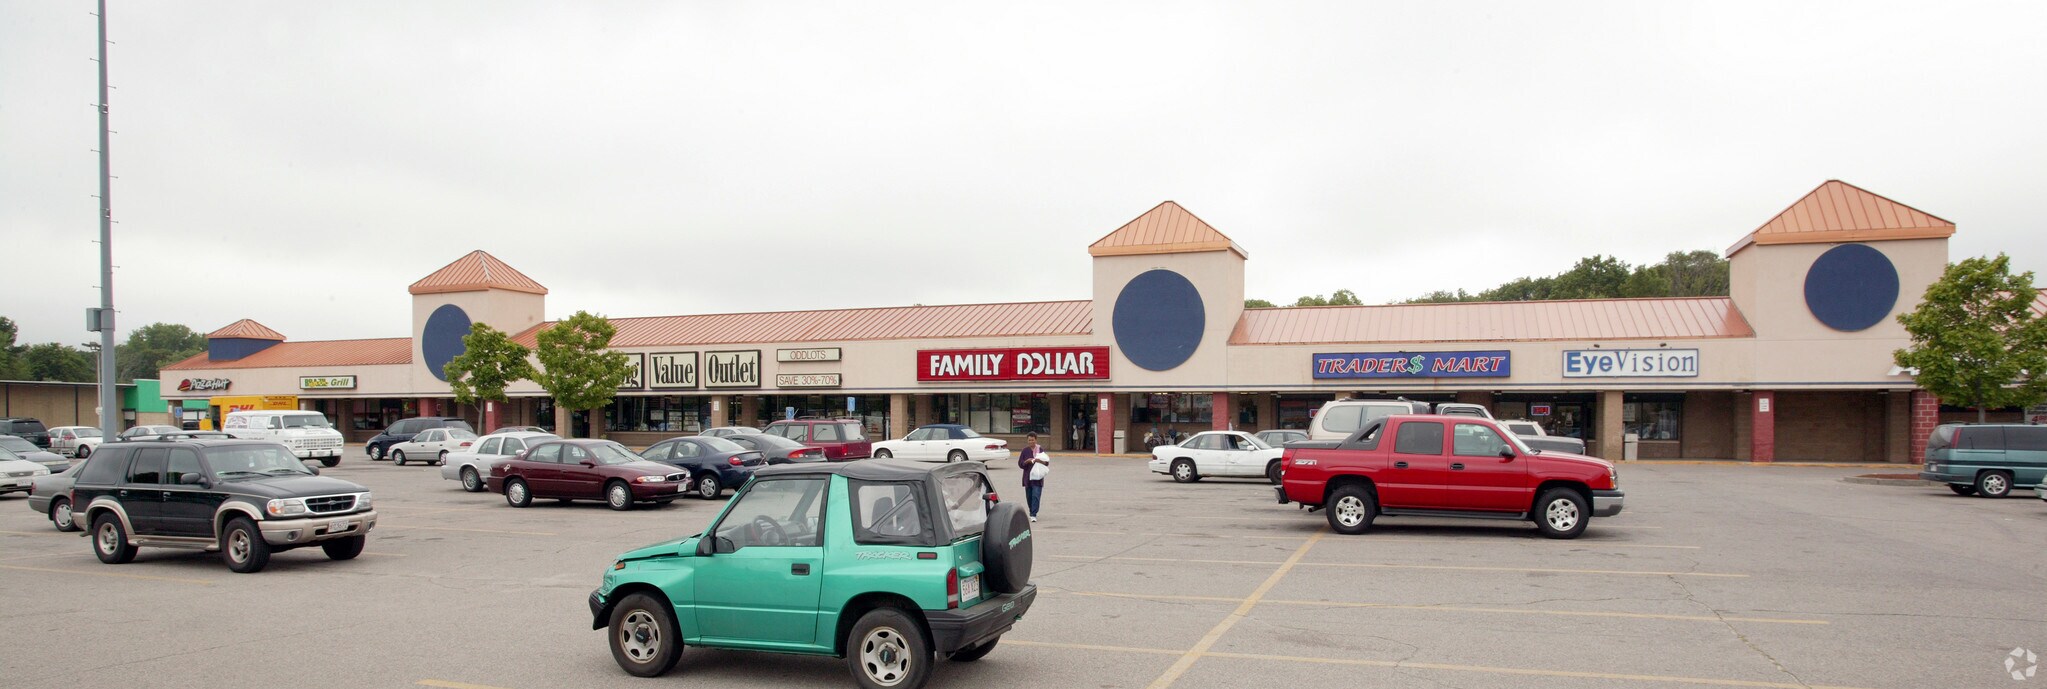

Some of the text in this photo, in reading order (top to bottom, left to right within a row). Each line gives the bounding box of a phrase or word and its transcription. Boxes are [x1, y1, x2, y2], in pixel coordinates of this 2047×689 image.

[790, 350, 826, 360] ODDLOTS
[930, 351, 1094, 376] FAMILY DOLLAR
[1318, 355, 1505, 374] TRADER$ MART
[1566, 350, 1696, 375] EyeVision
[653, 356, 694, 384] Value
[708, 354, 756, 383] Outlet
[211, 378, 229, 390] Hut
[330, 378, 350, 387] Grill
[779, 375, 838, 385] SAVE 30%-70%
[856, 551, 913, 560] TRACKER
